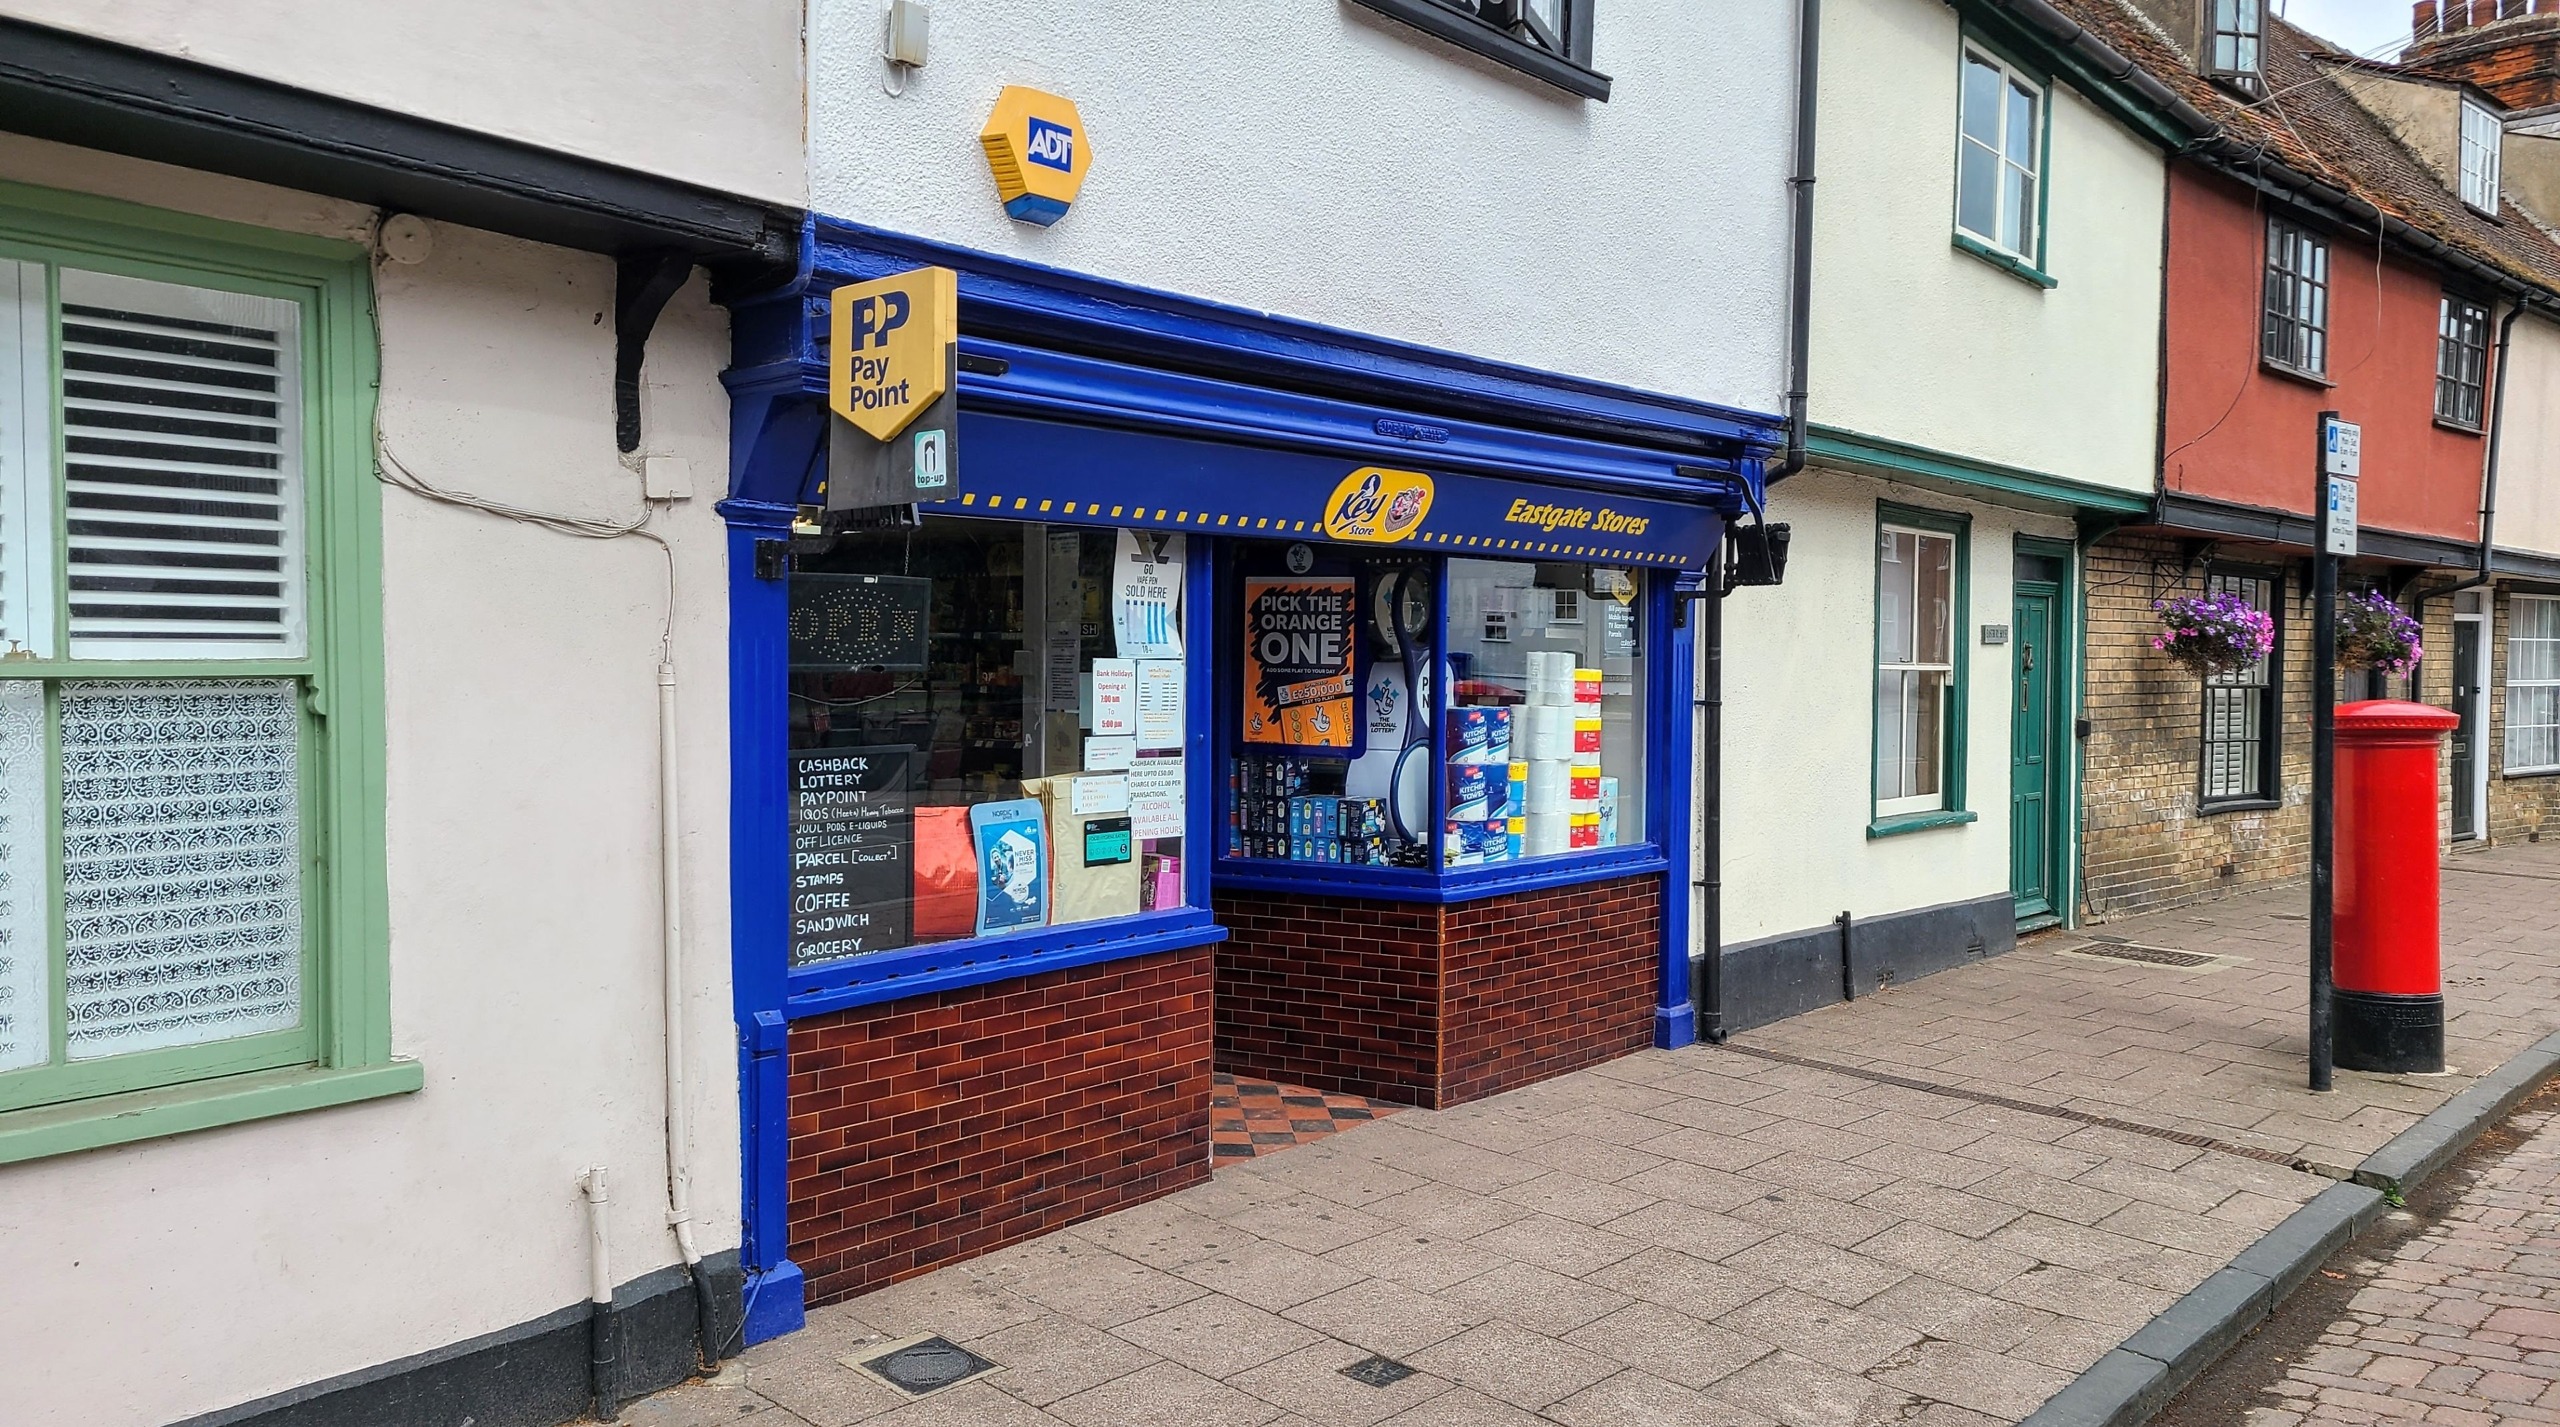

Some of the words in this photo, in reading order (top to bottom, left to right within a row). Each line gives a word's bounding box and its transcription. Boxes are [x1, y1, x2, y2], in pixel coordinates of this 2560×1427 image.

[1029, 128, 1072, 165] ADT
[852, 291, 910, 352] PP
[851, 356, 890, 386] Pay
[851, 378, 910, 413] Point
[917, 474, 945, 485] top-up
[1330, 492, 1389, 526] Key
[1505, 498, 1592, 532] Eastgate
[1592, 509, 1650, 535] Stores
[1349, 525, 1375, 536] Store
[1144, 564, 1154, 575] GO
[1137, 576, 1148, 584] VAPE
[1126, 585, 1145, 597] SOLD
[1148, 587, 1167, 598] HERE
[1261, 596, 1302, 611] PICK
[1307, 596, 1342, 611] THE
[789, 608, 918, 641] OPEN
[1261, 614, 1342, 630] ORANGE
[1261, 632, 1342, 665] ONE
[1111, 670, 1133, 679] Holidays
[1098, 683, 1120, 691] Opening
[1292, 683, 1342, 700] £250,000
[799, 757, 869, 773] CASHBACK
[800, 774, 863, 789] LOTTERY
[800, 791, 867, 807] PAYPOINT
[1141, 802, 1170, 810] ALCOHOL
[800, 808, 829, 820] IQOS
[880, 804, 904, 815] Tobacco
[992, 809, 1012, 817] NORDIC
[1133, 814, 1166, 824] AVAILABLE
[796, 824, 823, 834] JUUL
[827, 822, 846, 832] PODS
[850, 820, 887, 830] E-LIQUIDS
[1160, 826, 1182, 834] HOURS
[796, 836, 818, 849] OFF
[820, 834, 863, 847] LICENCE
[1015, 849, 1034, 857] NEVER
[796, 853, 849, 869] PARCEL
[796, 873, 844, 888] STAMPS
[796, 893, 850, 914] COFFEE
[796, 913, 870, 935] SANDWICH
[796, 938, 863, 958] GROCERY
